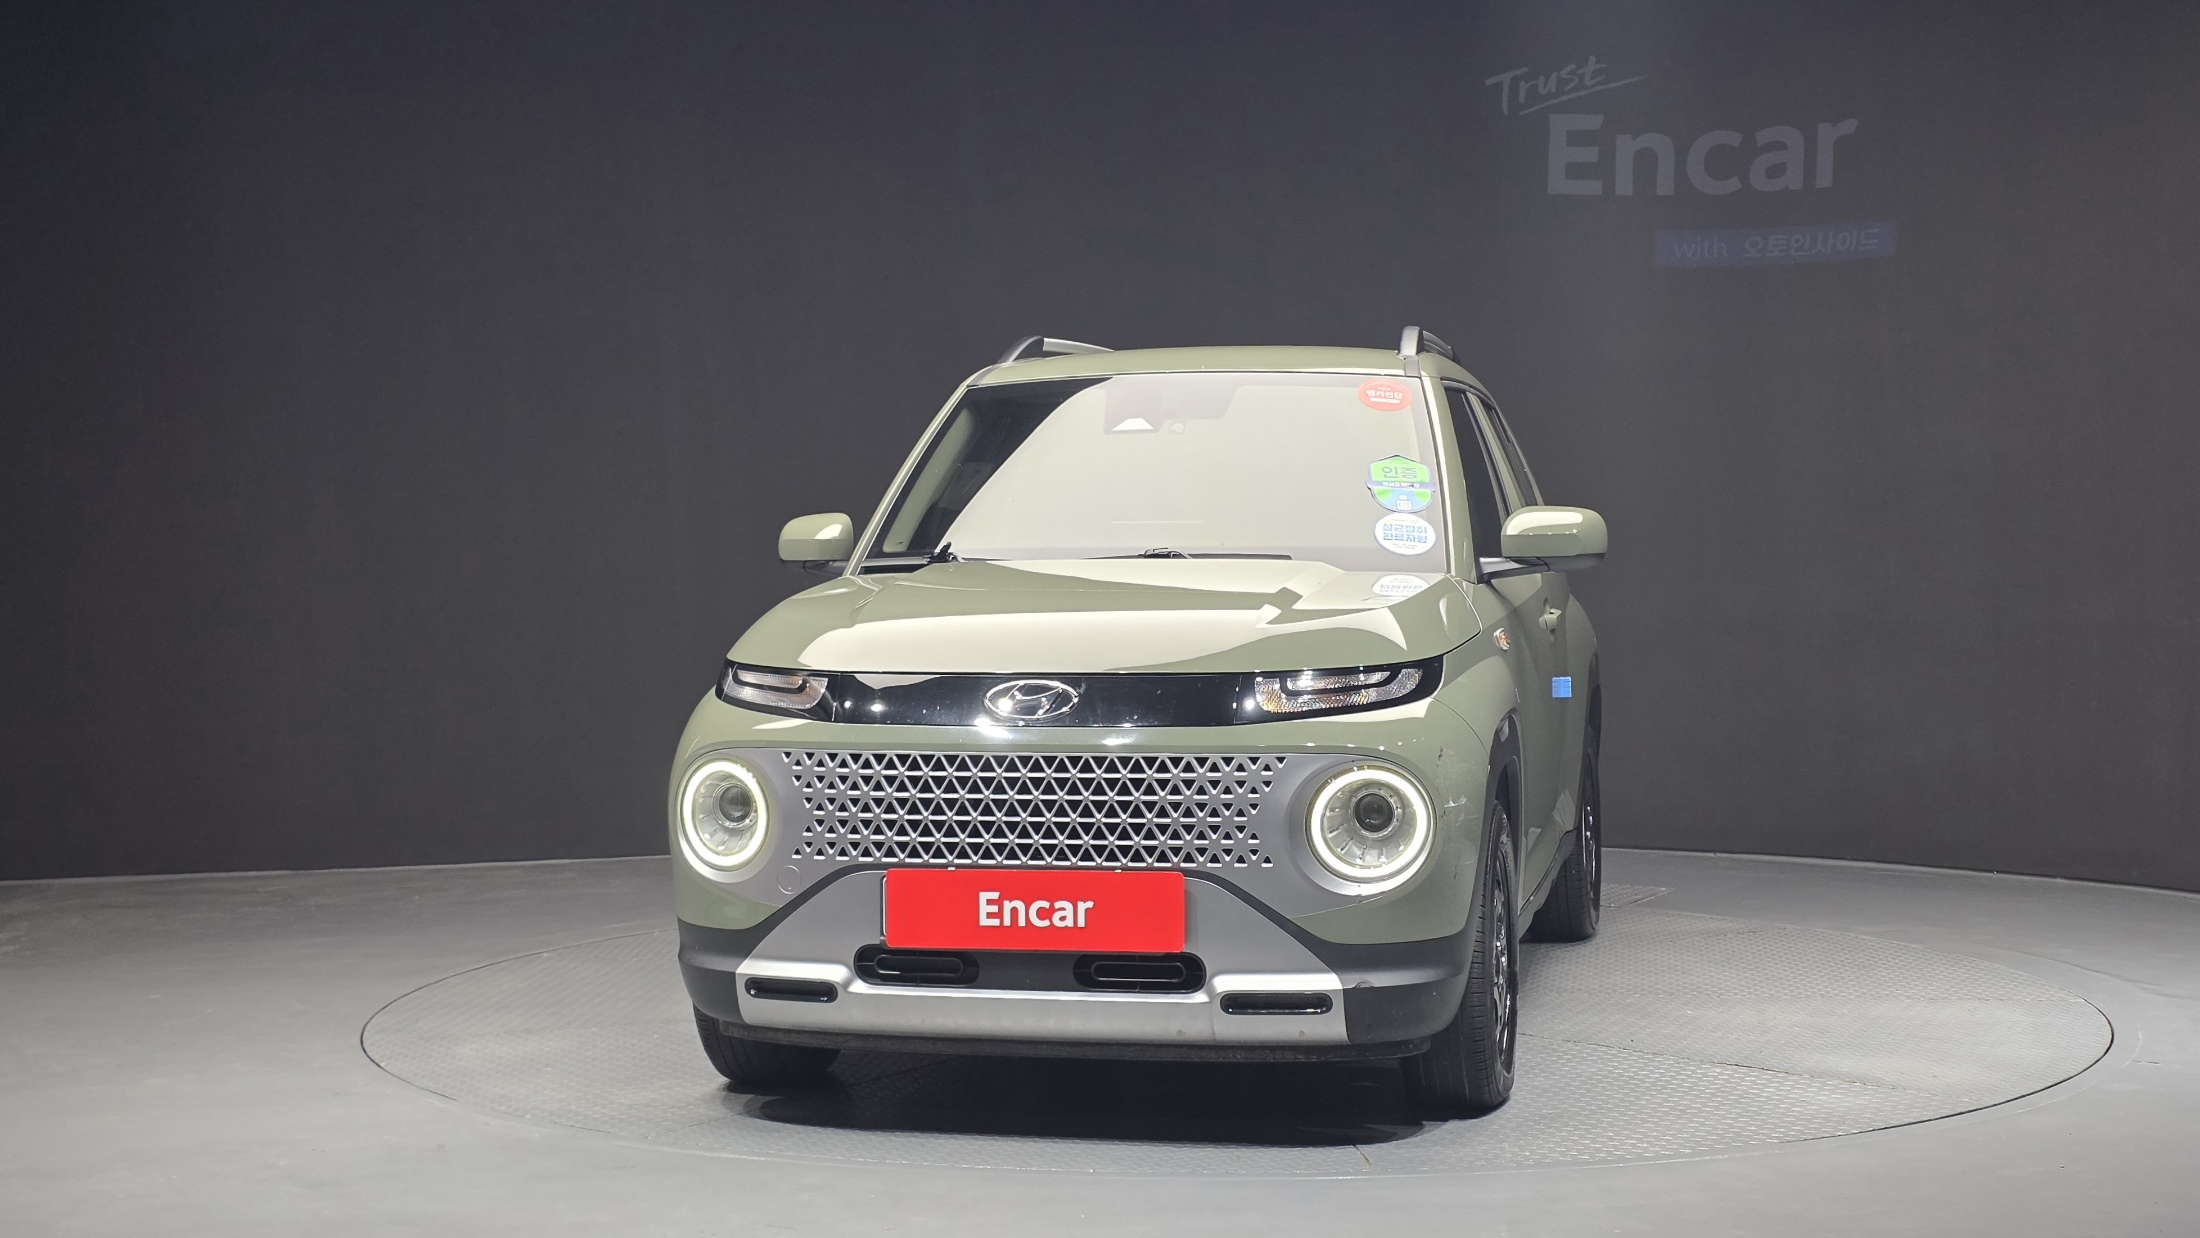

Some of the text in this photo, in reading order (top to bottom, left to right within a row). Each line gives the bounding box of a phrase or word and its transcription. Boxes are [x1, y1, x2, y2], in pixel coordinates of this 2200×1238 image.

[1485, 55, 1609, 114] Trust
[1547, 113, 1859, 196] Encar
[1673, 229, 1881, 258] with 오토인사이드
[1382, 466, 1417, 479] 인증
[978, 891, 1094, 928] Encar
